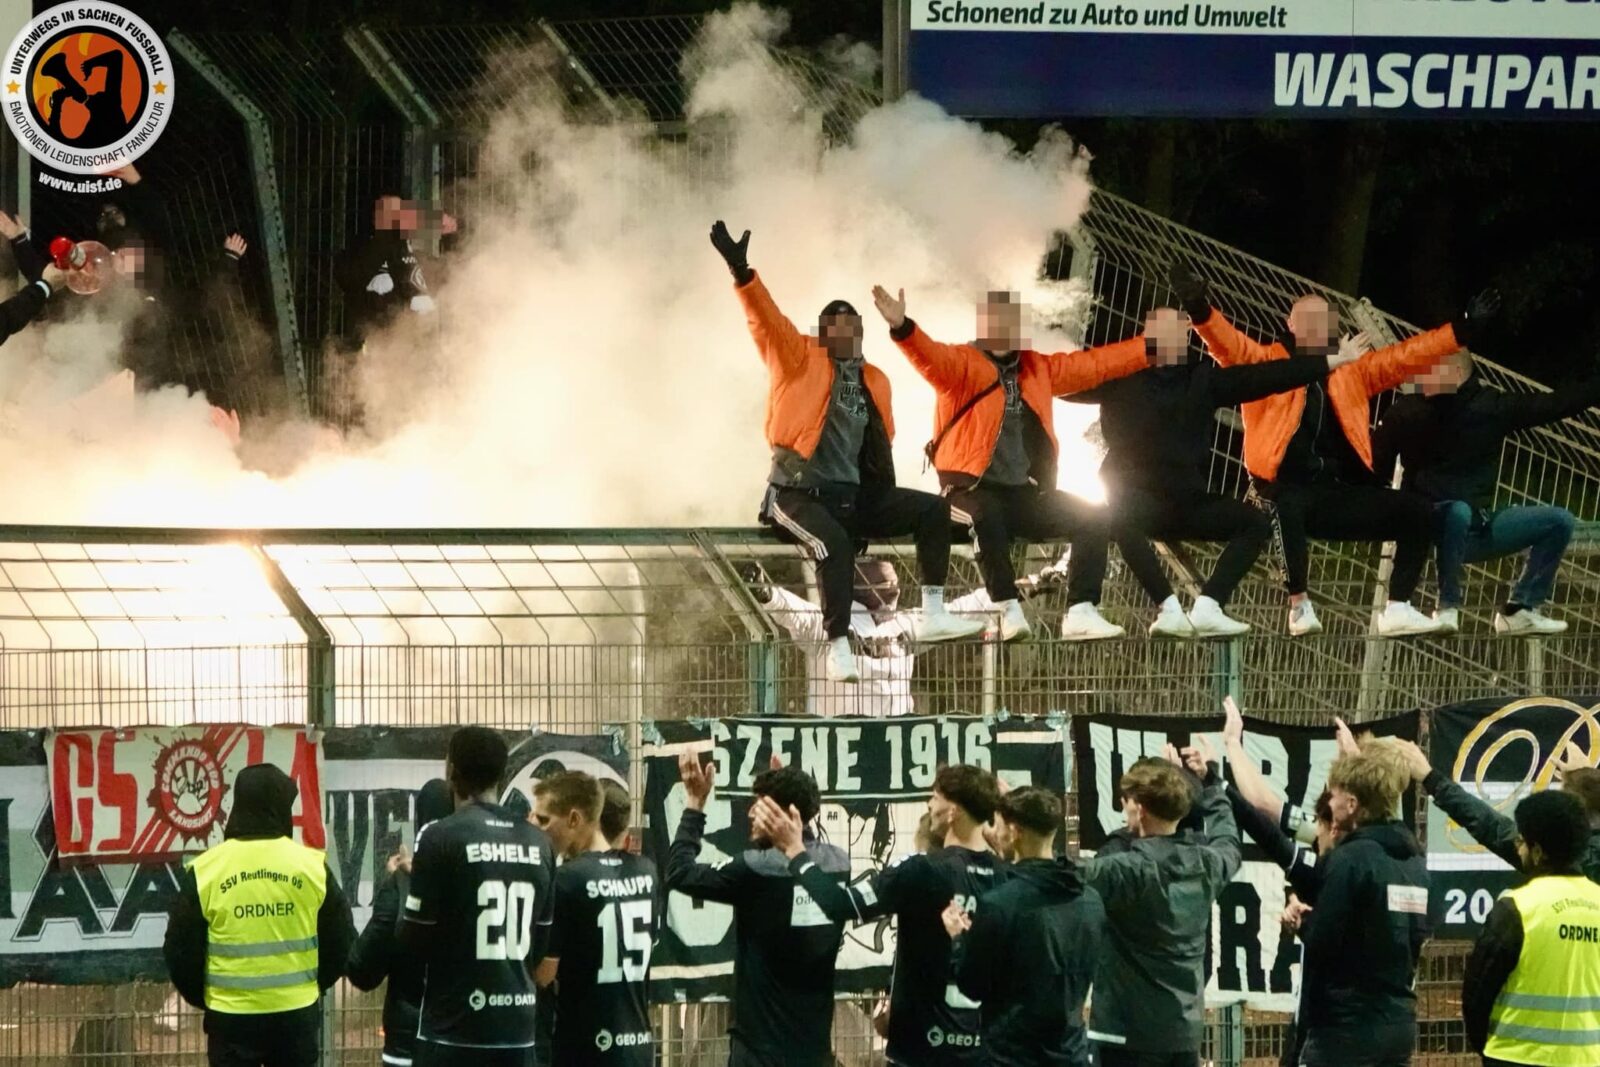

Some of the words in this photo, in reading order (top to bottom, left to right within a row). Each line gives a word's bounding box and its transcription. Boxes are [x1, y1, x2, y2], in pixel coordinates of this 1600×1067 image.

[927, 1, 1044, 24] Schonend
[1050, 6, 1076, 25] zu
[1081, 2, 1138, 26] Auto
[1143, 4, 1188, 26] und
[1194, 5, 1288, 28] Umwelt
[1274, 52, 1600, 109] WASCHPAR
[886, 723, 992, 790] 1916
[466, 842, 541, 866] ESHELE
[220, 874, 238, 894] SSV
[240, 867, 289, 883] Reutlingen
[586, 875, 653, 898] SCHAUPP
[234, 902, 294, 919] ORDNER
[476, 880, 535, 961] 20
[597, 900, 652, 984] 15
[1559, 924, 1600, 943] ORDNE
[489, 994, 513, 1006] GEO
[615, 1032, 636, 1046] GEO
[947, 1033, 973, 1047] GEO
